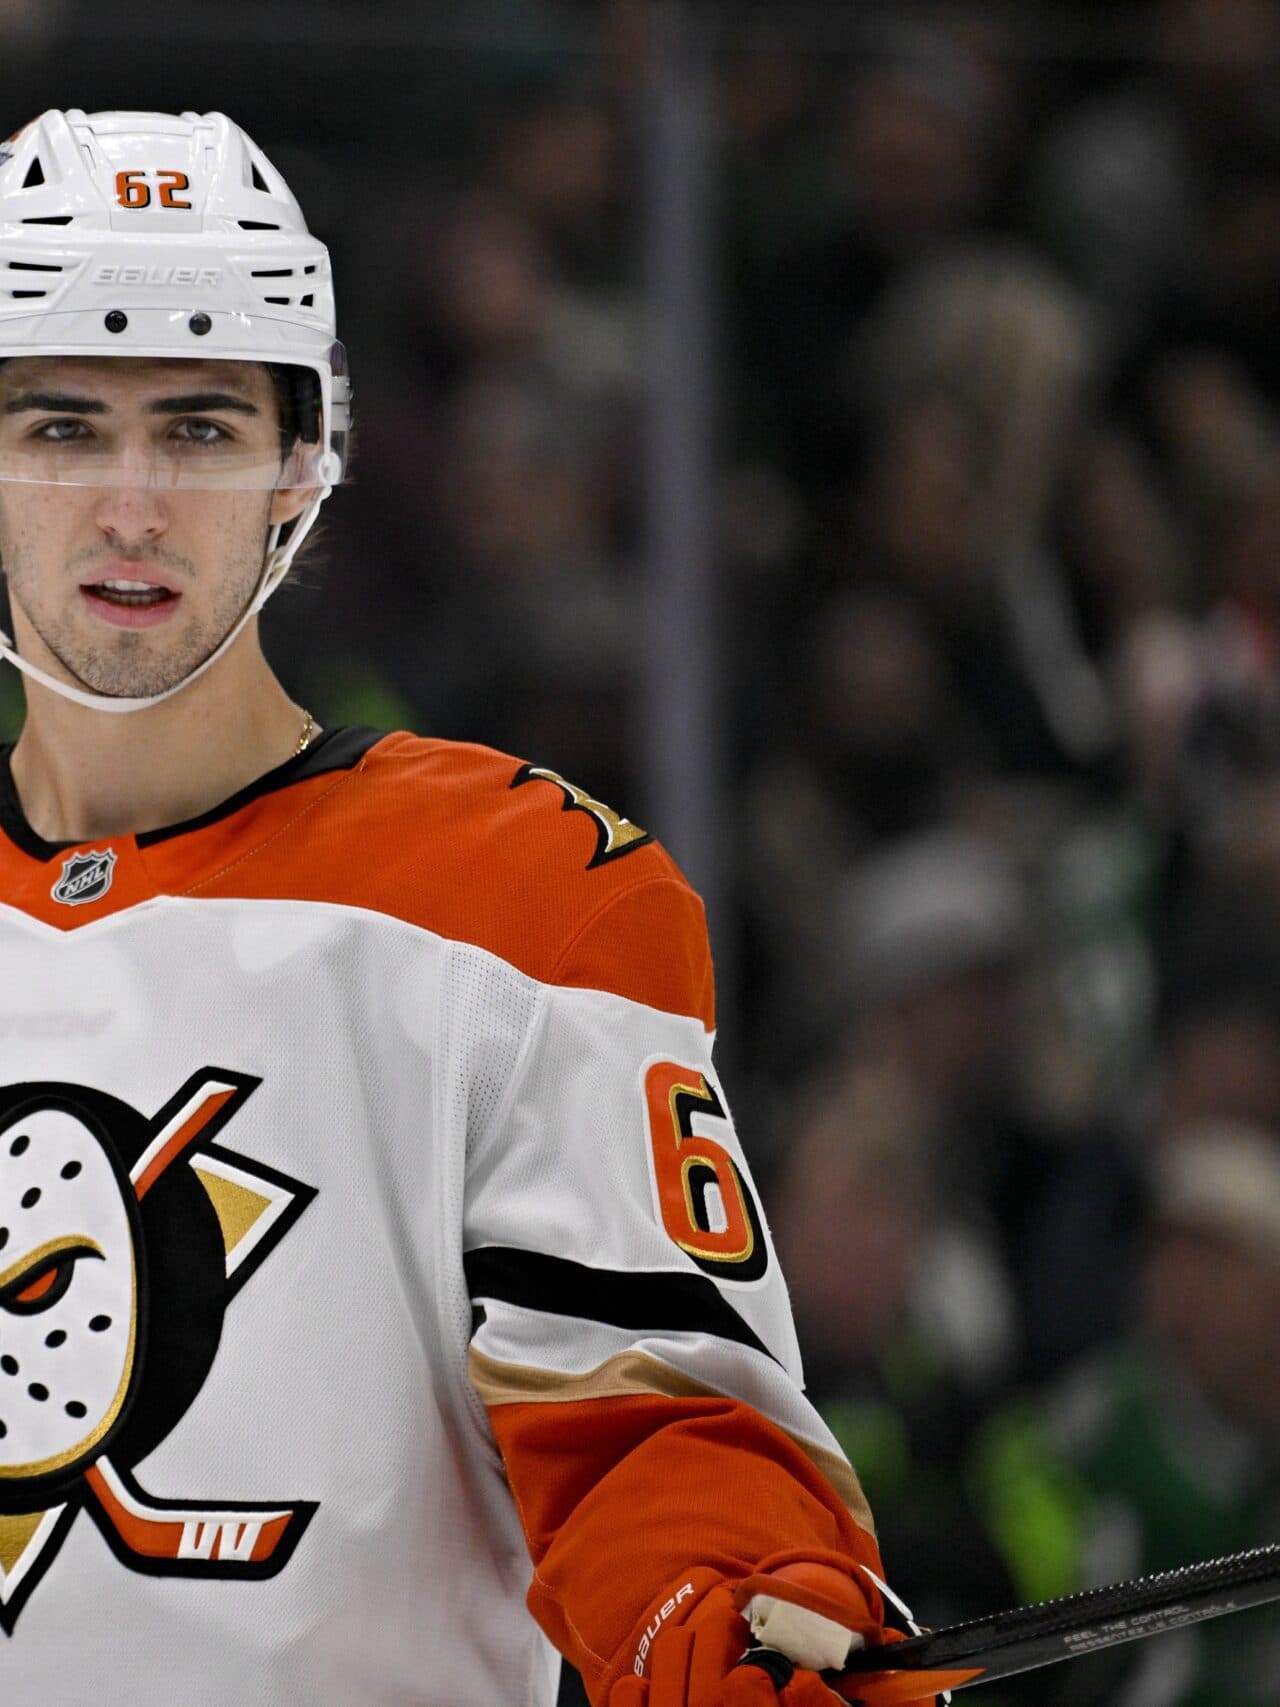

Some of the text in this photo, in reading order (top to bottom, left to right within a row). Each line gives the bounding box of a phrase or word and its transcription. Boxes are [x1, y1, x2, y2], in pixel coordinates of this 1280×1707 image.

[115, 170, 192, 209] 62
[92, 264, 221, 288] BAUER
[63, 865, 105, 897] NHL
[633, 1583, 695, 1678] BAUER
[1063, 1605, 1190, 1645] FEEL THE CONTROL
